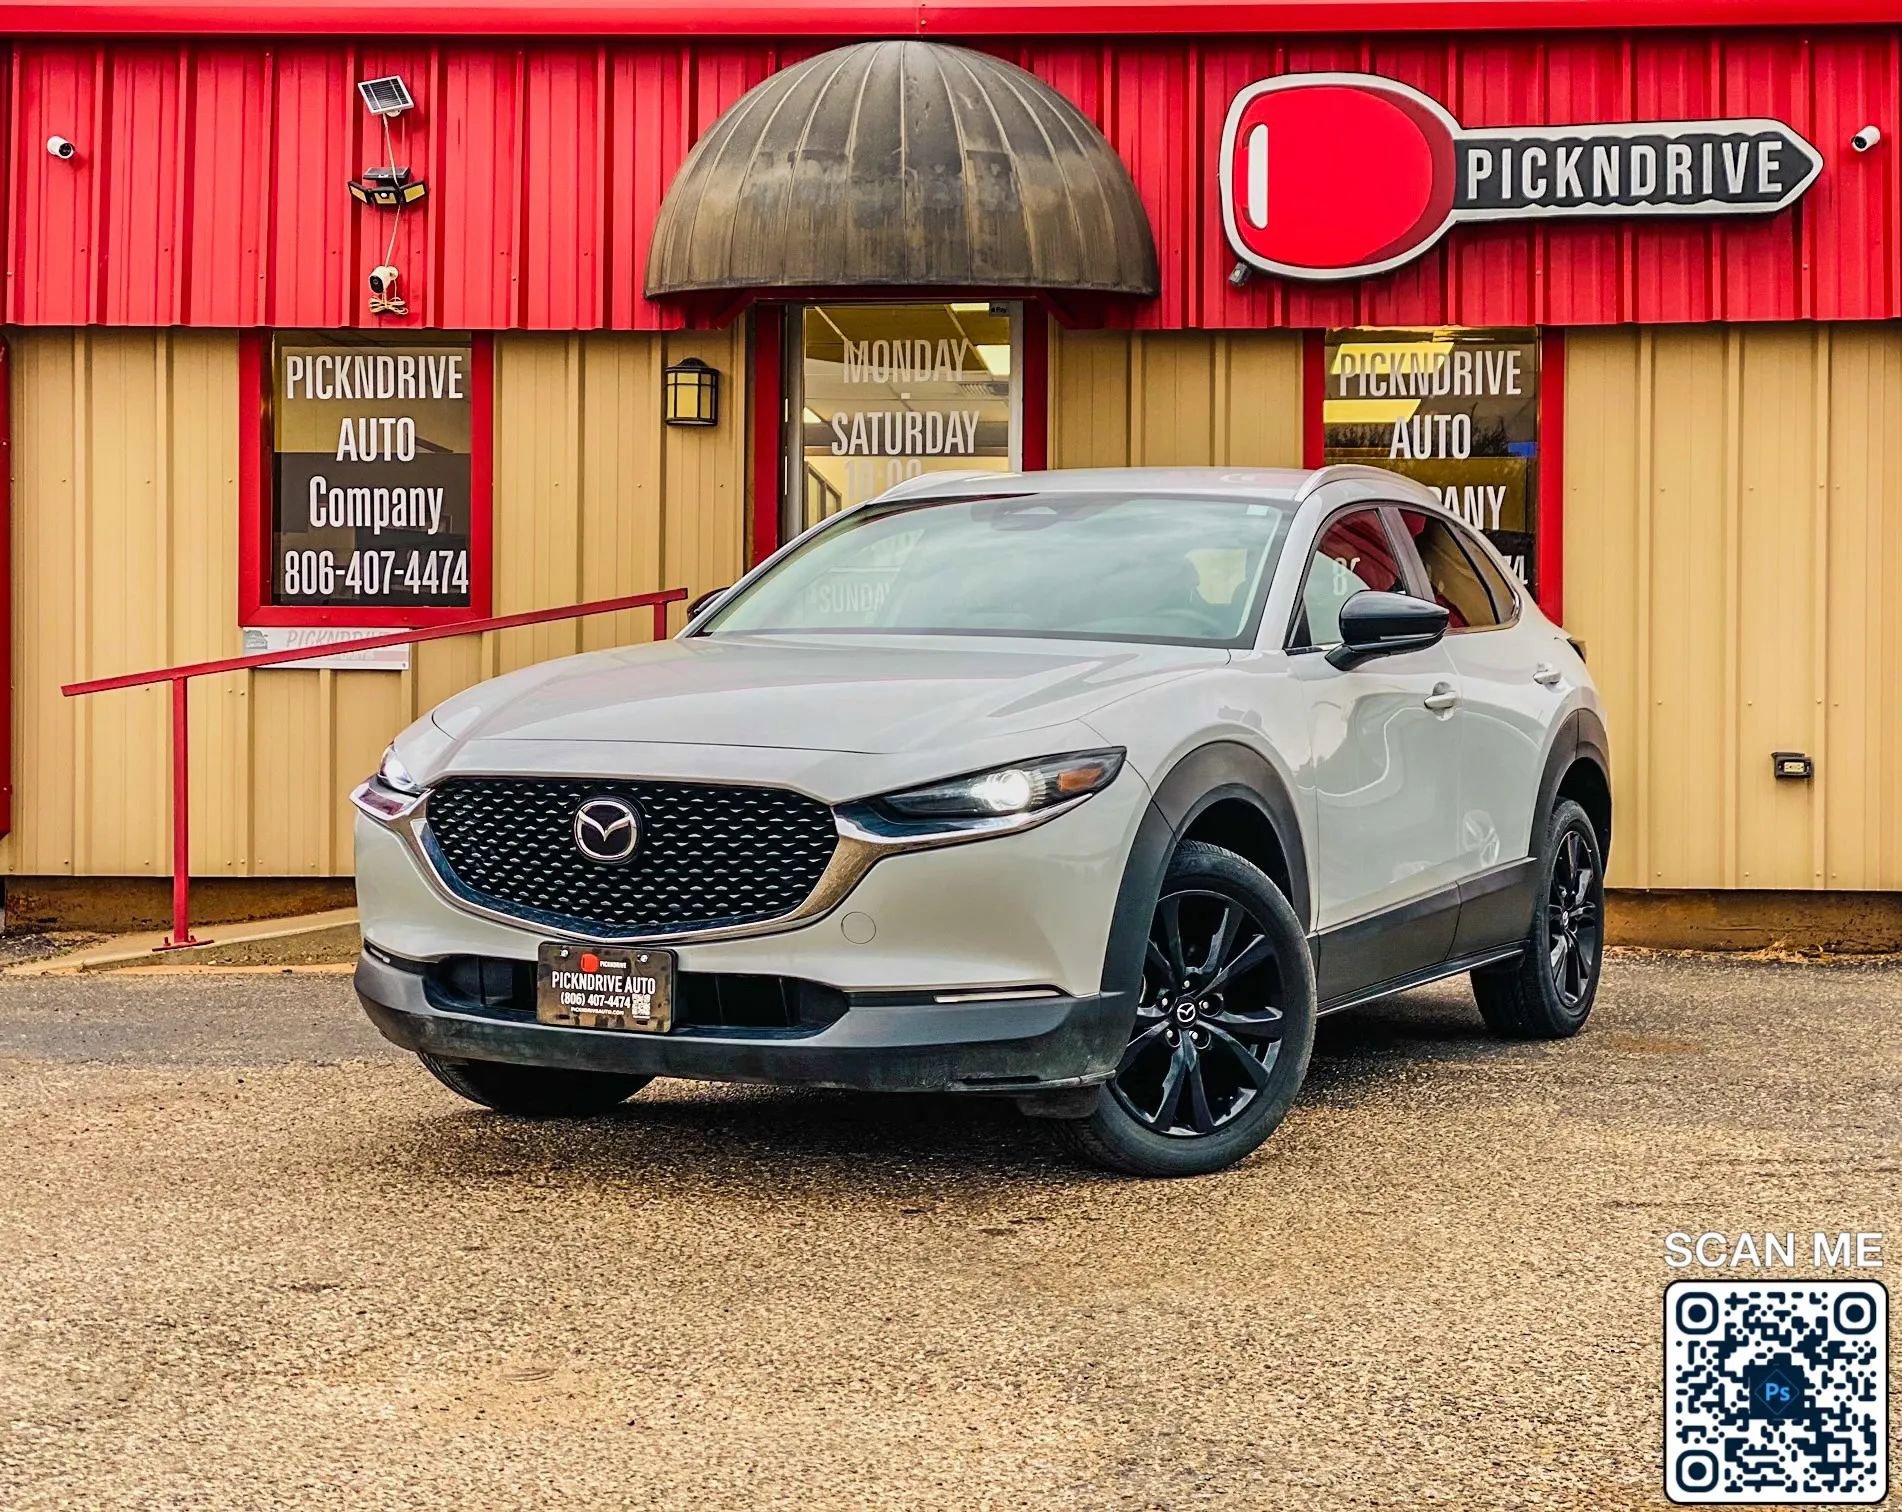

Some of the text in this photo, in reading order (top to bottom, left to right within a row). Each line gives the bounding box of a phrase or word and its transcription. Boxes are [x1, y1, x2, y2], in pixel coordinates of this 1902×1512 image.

[1467, 140, 1783, 199] PICKNDRIVE
[286, 355, 463, 399] PICKNDRIVE
[843, 338, 969, 384] MONDAY
[1339, 350, 1521, 396] PICKNDRIVE
[336, 417, 416, 462] AUTO
[831, 411, 980, 456] SATURDAY
[1389, 414, 1472, 459] AUTO
[309, 475, 444, 535] Company
[284, 550, 469, 595] 806-407-4474
[819, 583, 891, 613] SUNDA
[552, 971, 656, 995] PICKNDRIVE AUTO
[560, 992, 631, 1009] (806) 407-4474
